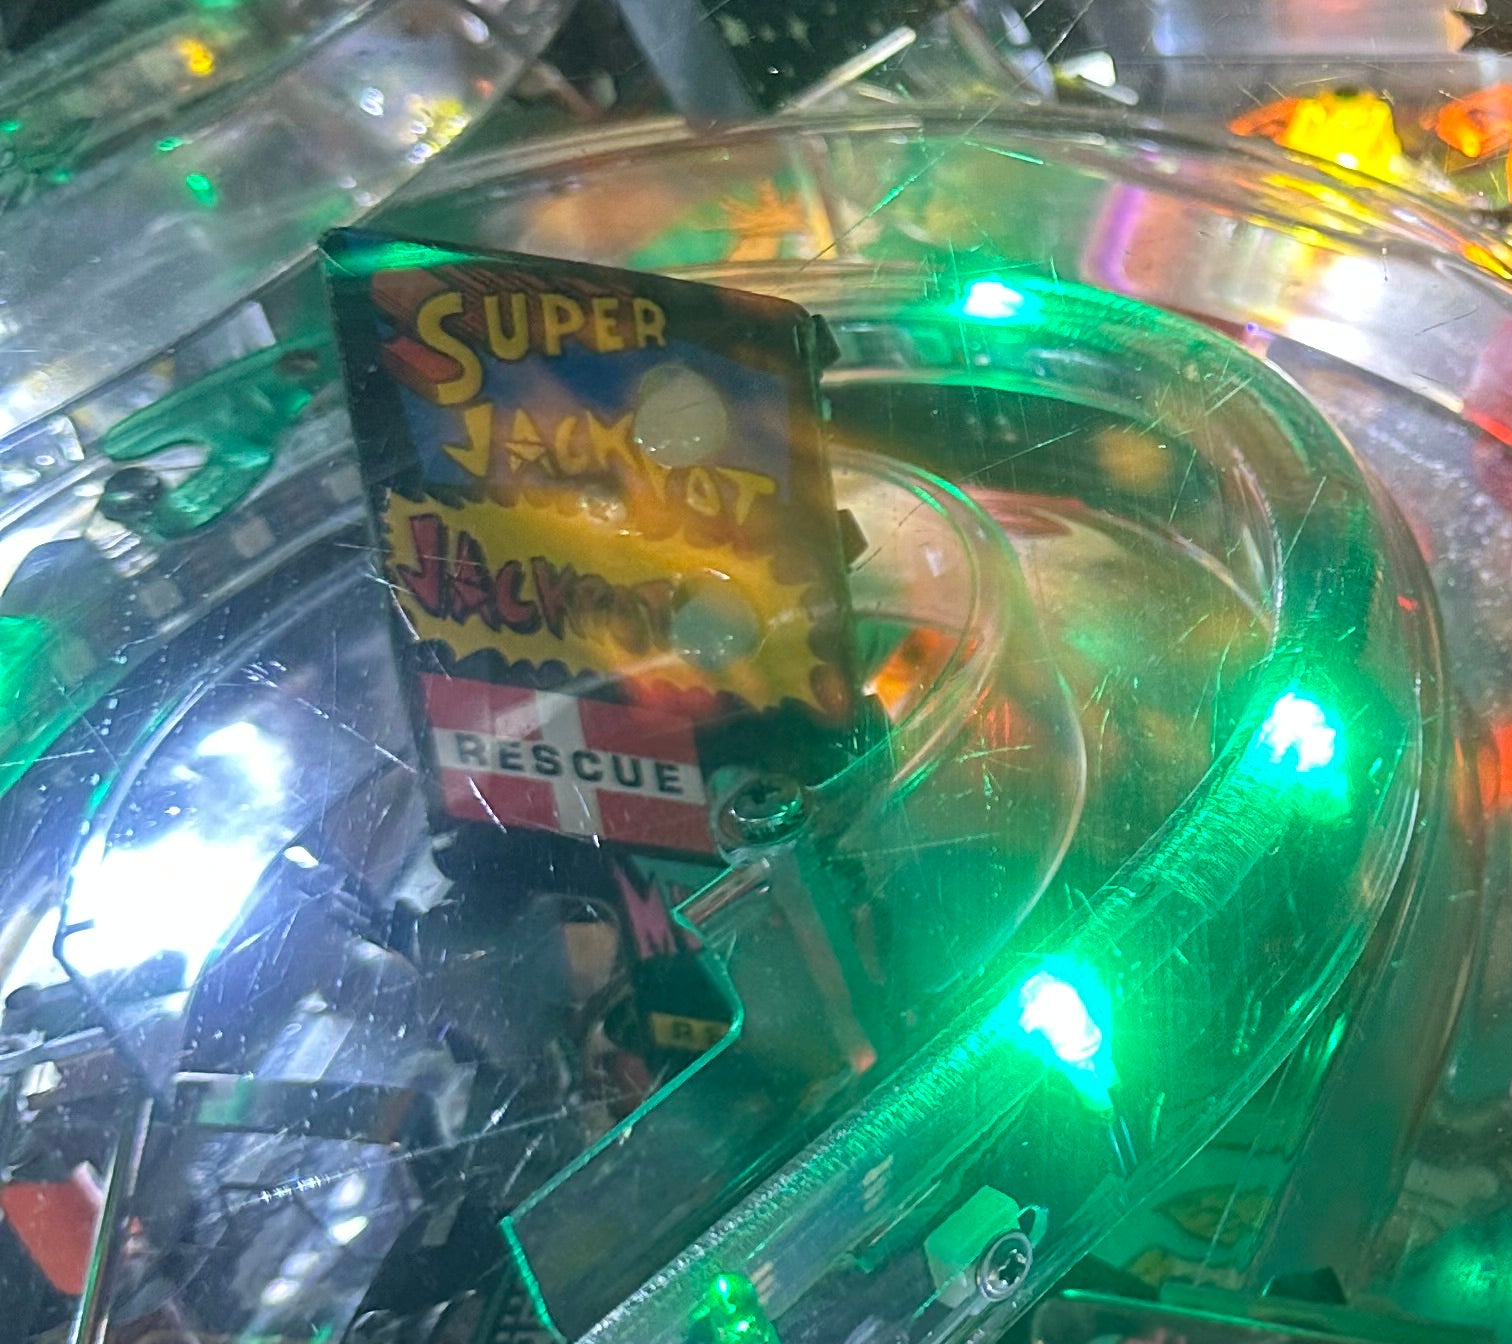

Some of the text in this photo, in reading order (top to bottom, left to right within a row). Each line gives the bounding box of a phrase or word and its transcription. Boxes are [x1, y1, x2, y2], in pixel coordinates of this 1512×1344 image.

[416, 290, 667, 405] SUPER
[443, 402, 776, 527] JACKOT
[456, 731, 684, 796] RESCUE
